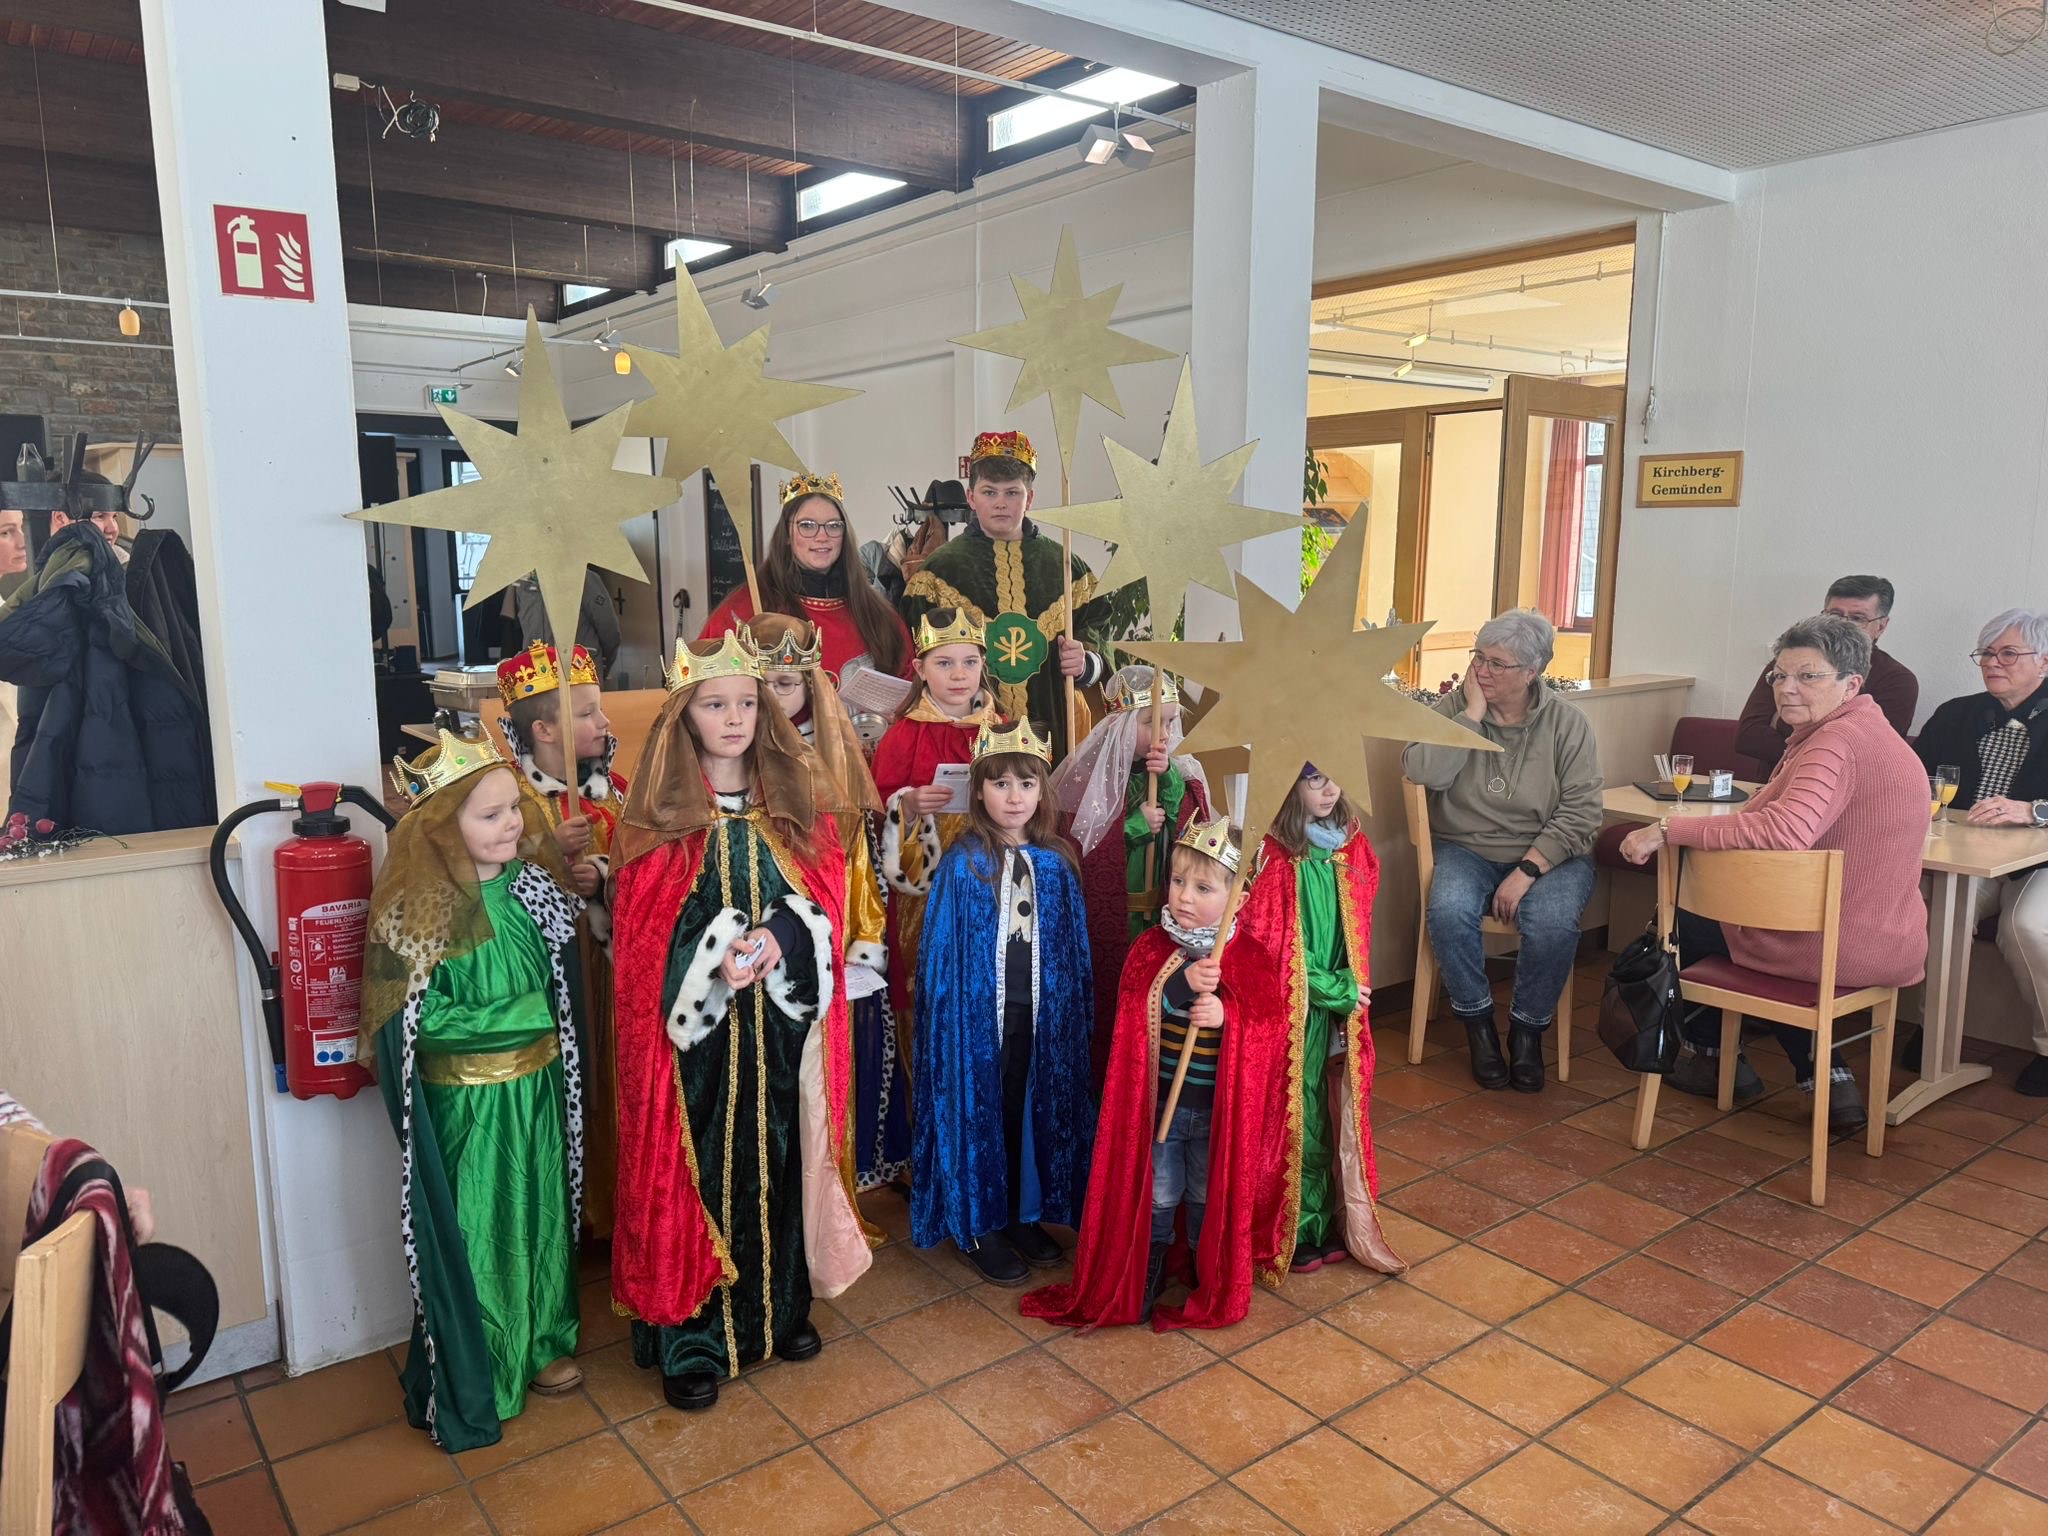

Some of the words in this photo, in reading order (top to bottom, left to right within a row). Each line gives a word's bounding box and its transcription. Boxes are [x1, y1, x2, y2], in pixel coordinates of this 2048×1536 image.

[1652, 466, 1725, 478] Kirchberg-
[1651, 483, 1722, 495] Gemünden
[321, 901, 362, 913] BAVARIA
